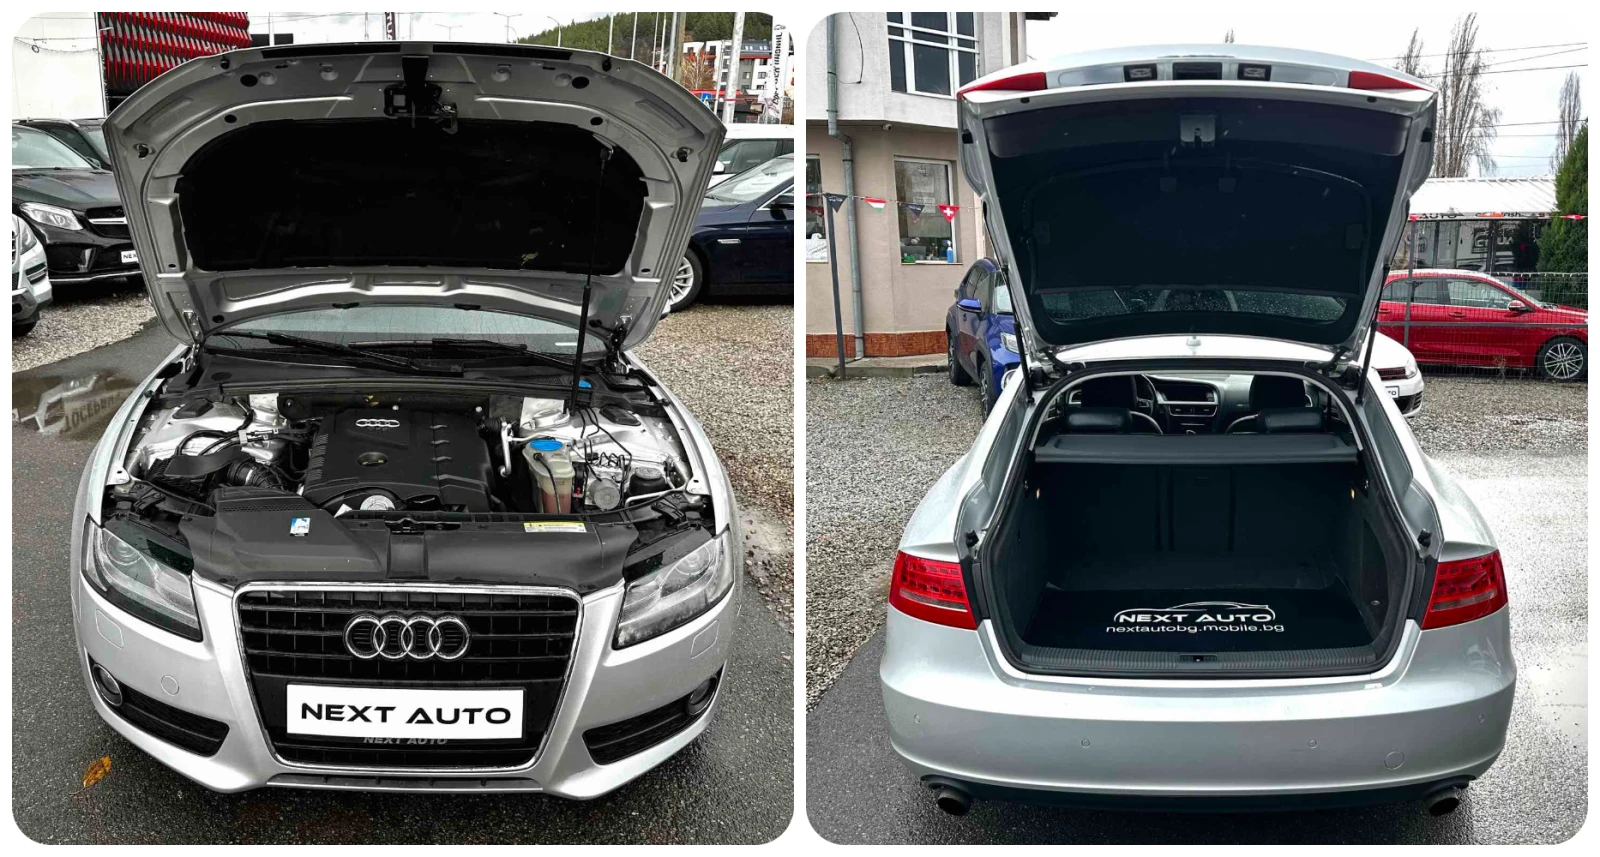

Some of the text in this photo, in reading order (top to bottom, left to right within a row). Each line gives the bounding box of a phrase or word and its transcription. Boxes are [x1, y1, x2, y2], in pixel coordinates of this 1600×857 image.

[1119, 614, 1272, 623] NEXT AUTO
[1106, 624, 1284, 633] nextautobg.mobile.bg
[301, 702, 511, 725] NEXT AUTO
